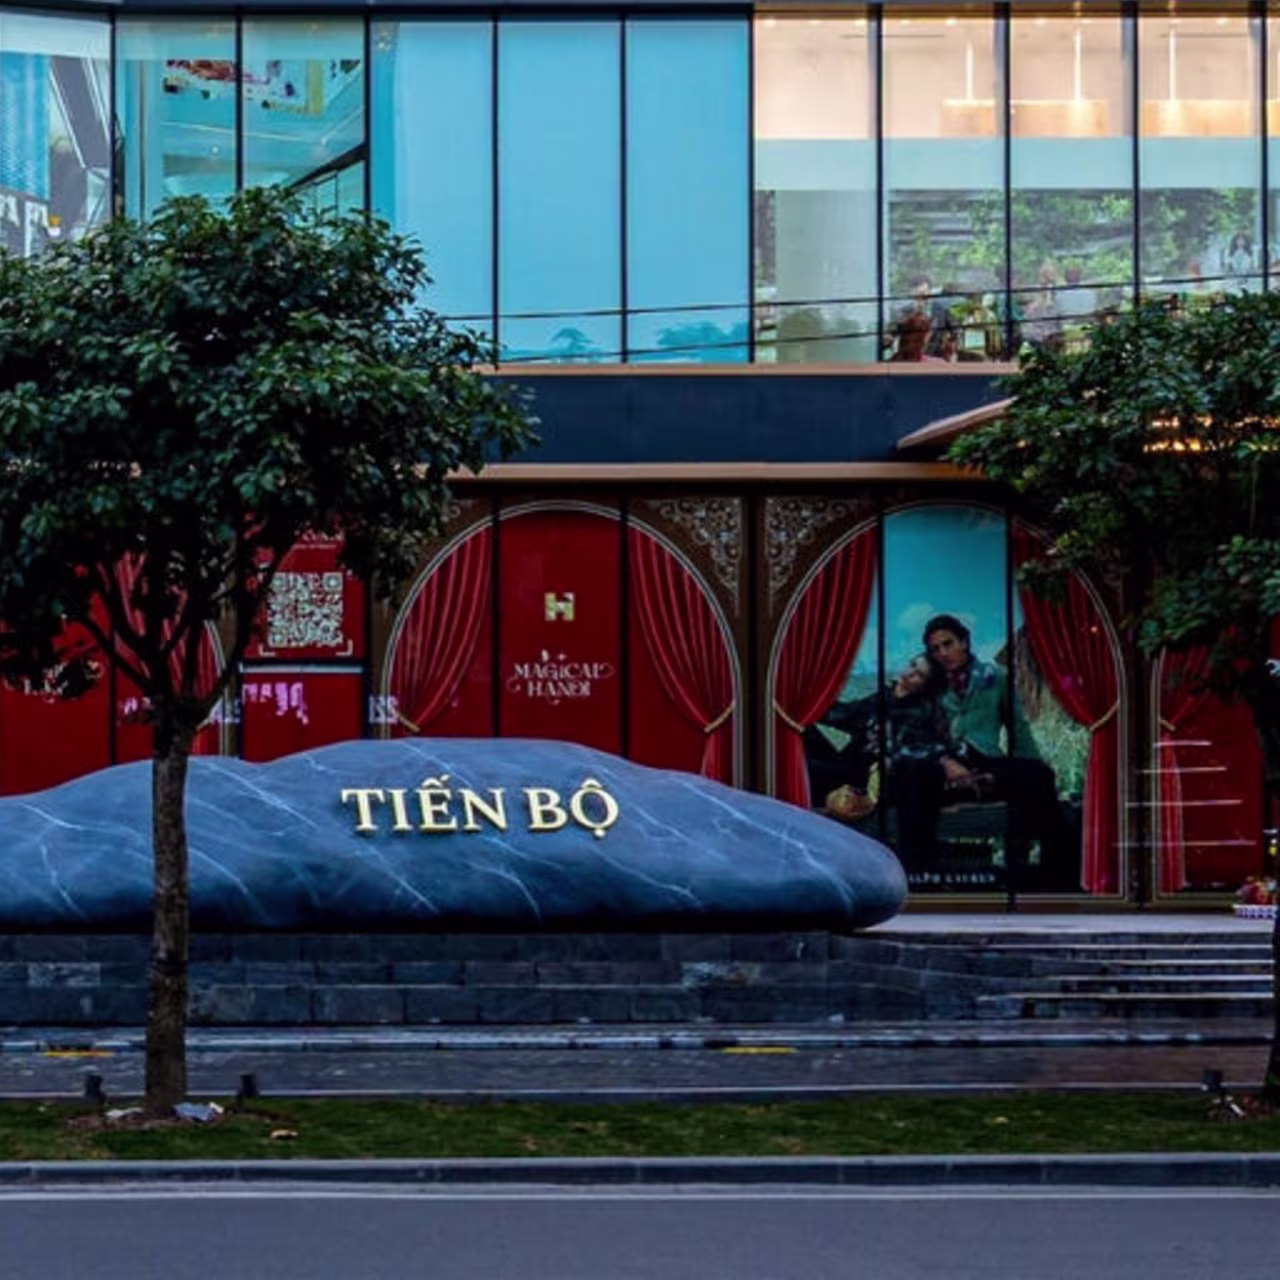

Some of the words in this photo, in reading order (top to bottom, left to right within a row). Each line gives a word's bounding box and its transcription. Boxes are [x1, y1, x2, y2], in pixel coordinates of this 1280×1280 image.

[526, 680, 591, 704] HANOI
[341, 774, 508, 832] TIẾN
[524, 777, 620, 839] BỘ
